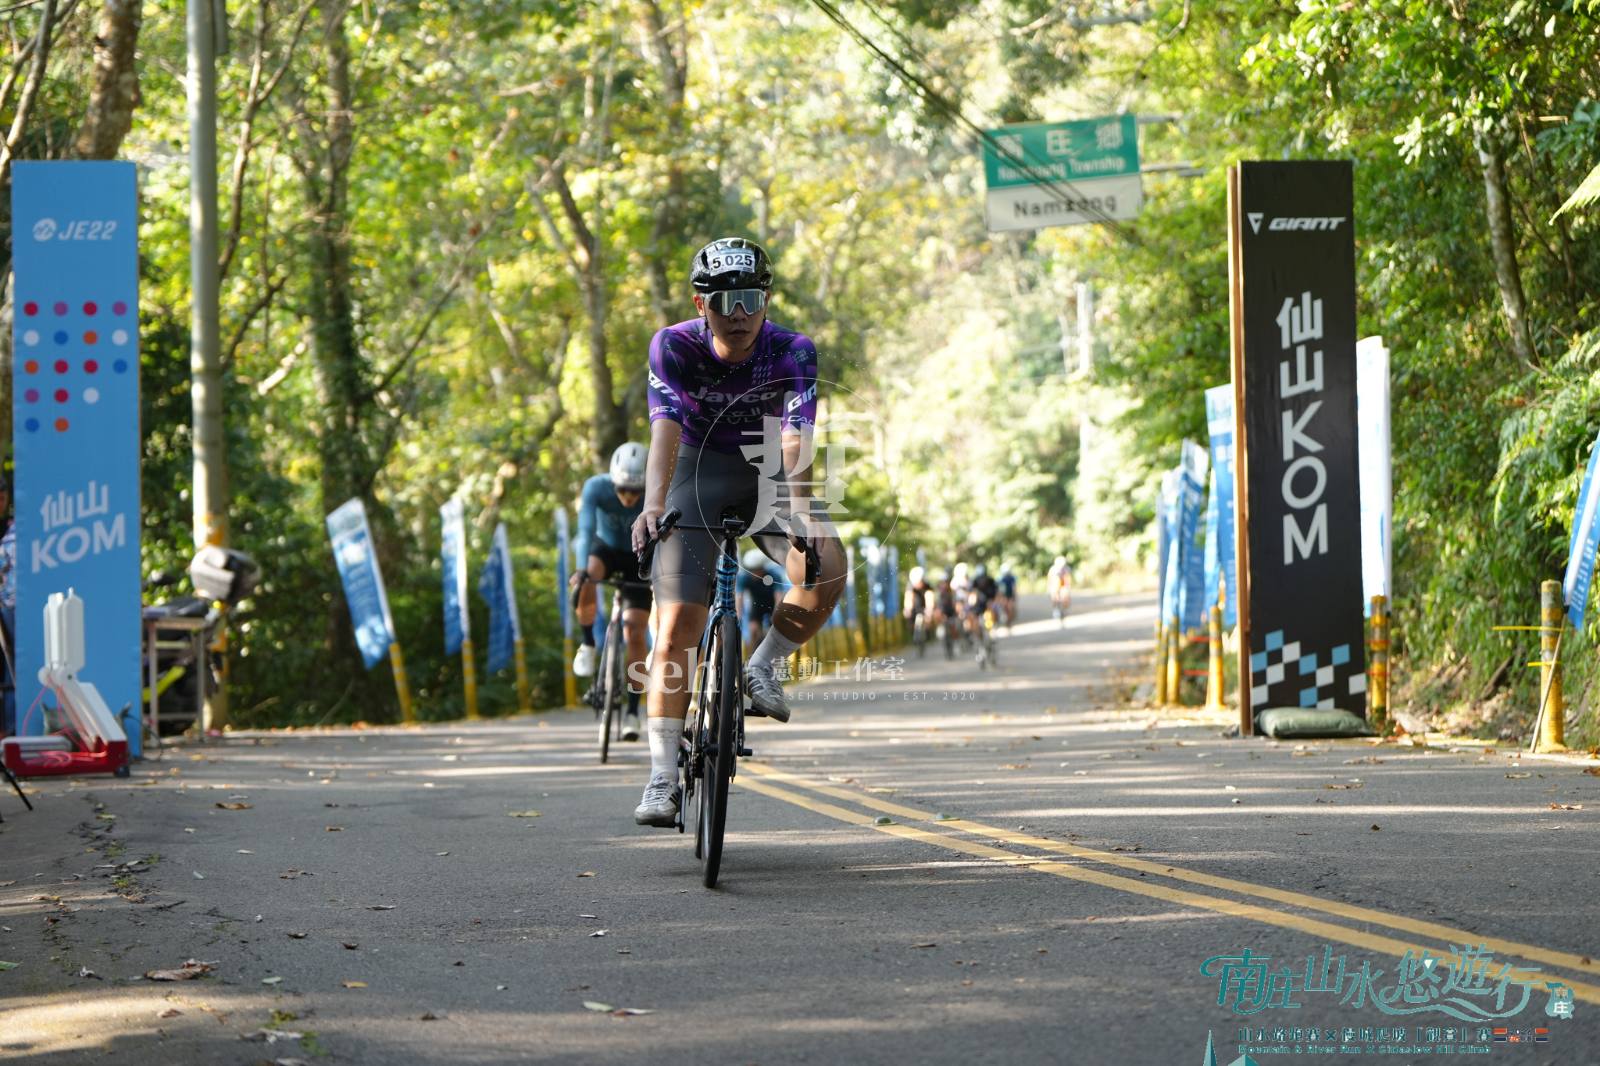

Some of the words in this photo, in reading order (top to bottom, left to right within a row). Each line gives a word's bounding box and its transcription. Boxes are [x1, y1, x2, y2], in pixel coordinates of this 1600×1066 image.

[58, 220, 117, 241] JE22
[1268, 216, 1346, 231] GIANT
[688, 386, 778, 406] Jayco
[787, 383, 817, 413] GIA
[40, 480, 109, 532] 仙山
[31, 513, 126, 574] KOM
